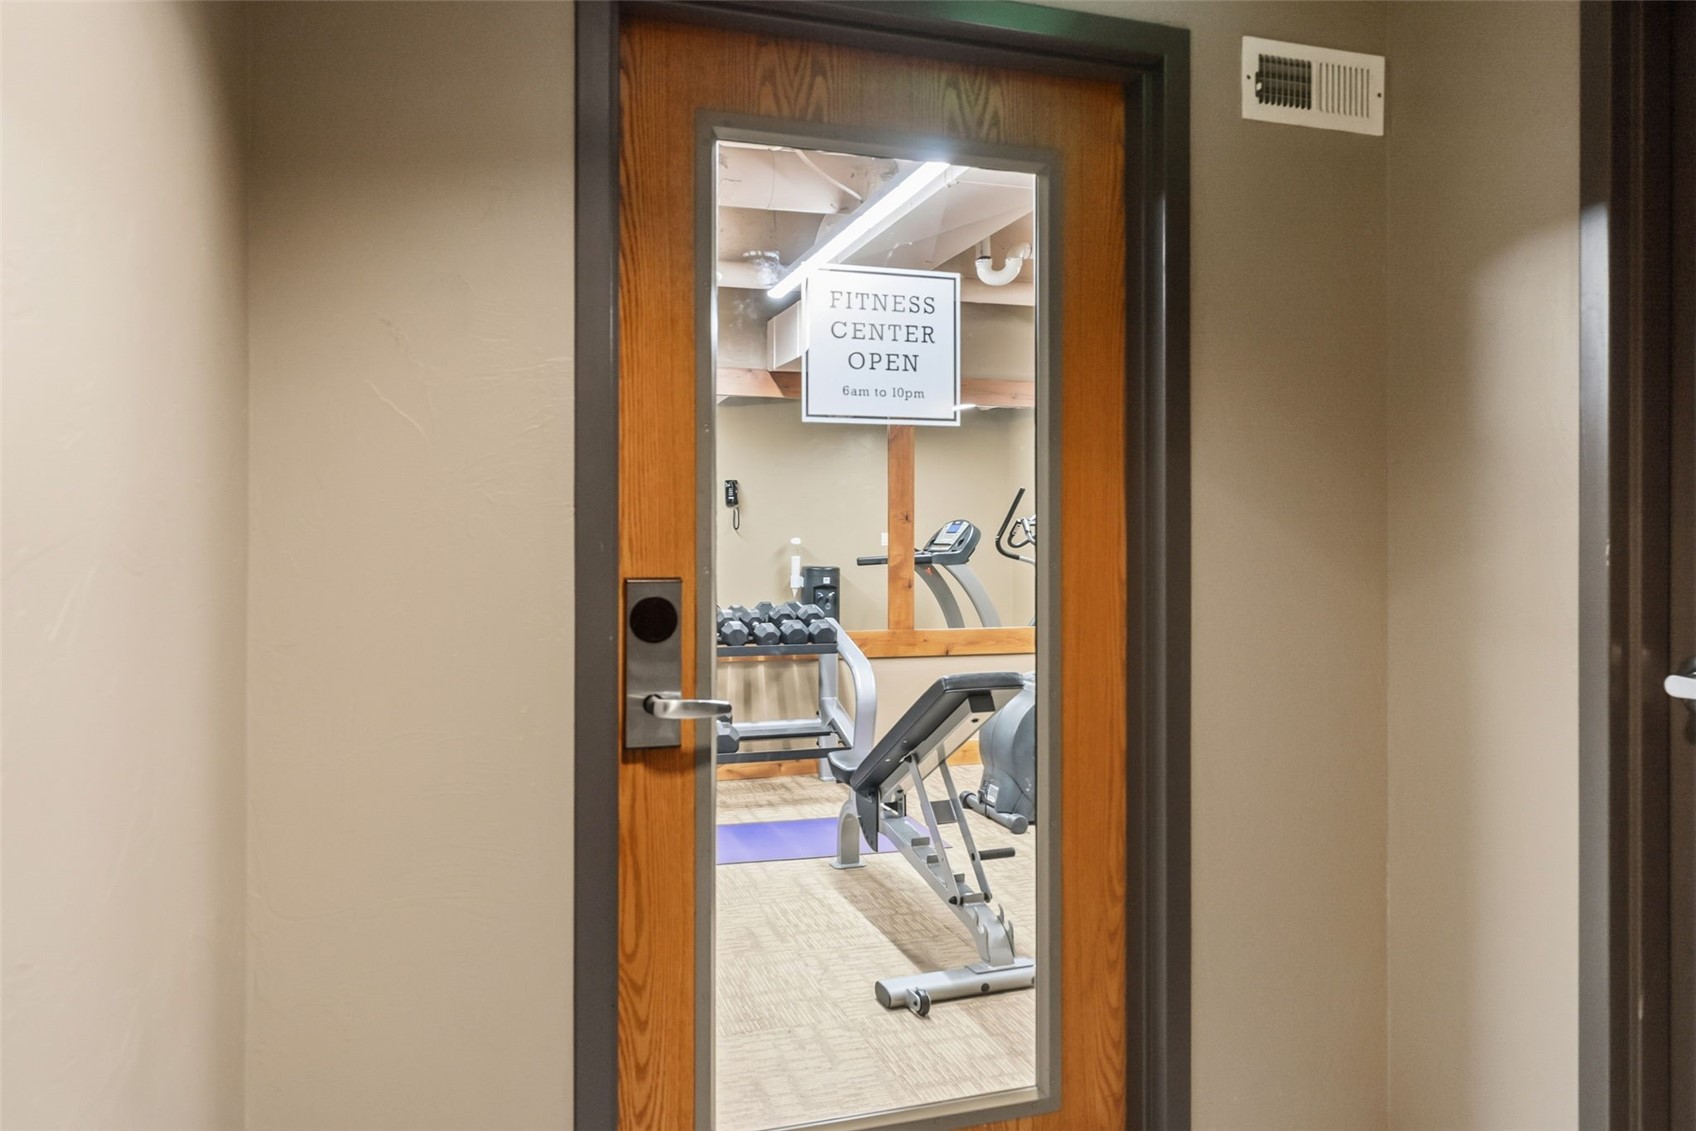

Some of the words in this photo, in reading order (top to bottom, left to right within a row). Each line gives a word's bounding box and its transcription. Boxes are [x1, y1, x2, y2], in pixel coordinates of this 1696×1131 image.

[830, 290, 935, 315] FITNESS
[831, 321, 935, 344] CENTER
[848, 352, 919, 372] OPEN
[842, 385, 870, 397] 6am
[875, 388, 887, 398] to
[892, 387, 925, 401] 10pm
